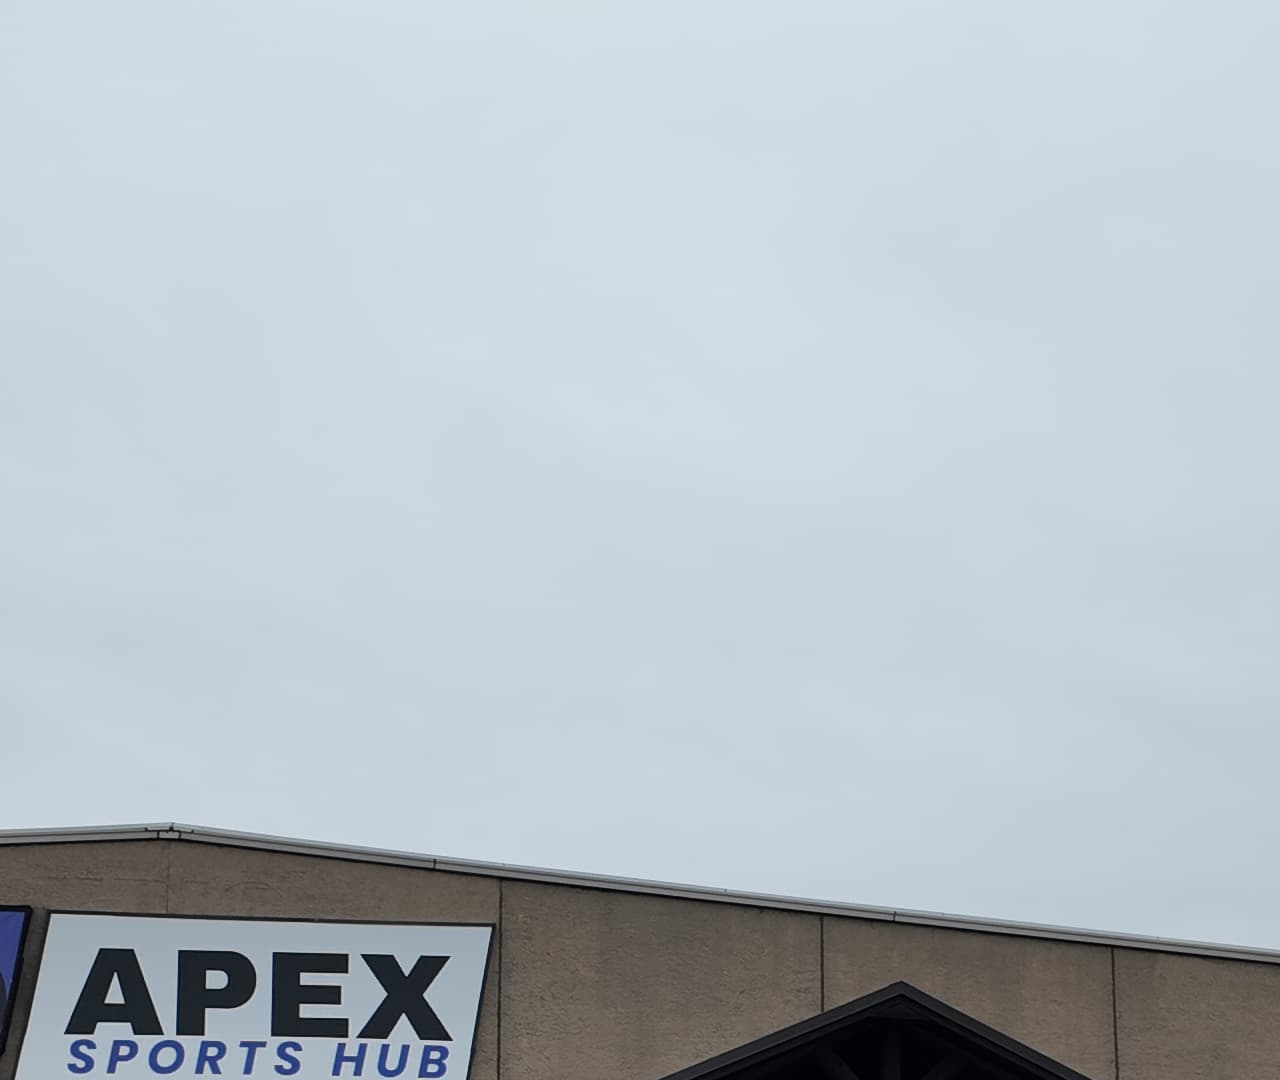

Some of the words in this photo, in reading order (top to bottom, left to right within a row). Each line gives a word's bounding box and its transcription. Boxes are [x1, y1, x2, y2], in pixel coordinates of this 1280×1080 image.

[64, 948, 454, 1042] APEX
[66, 1039, 303, 1076] SPORTS
[331, 1042, 451, 1079] HUB
